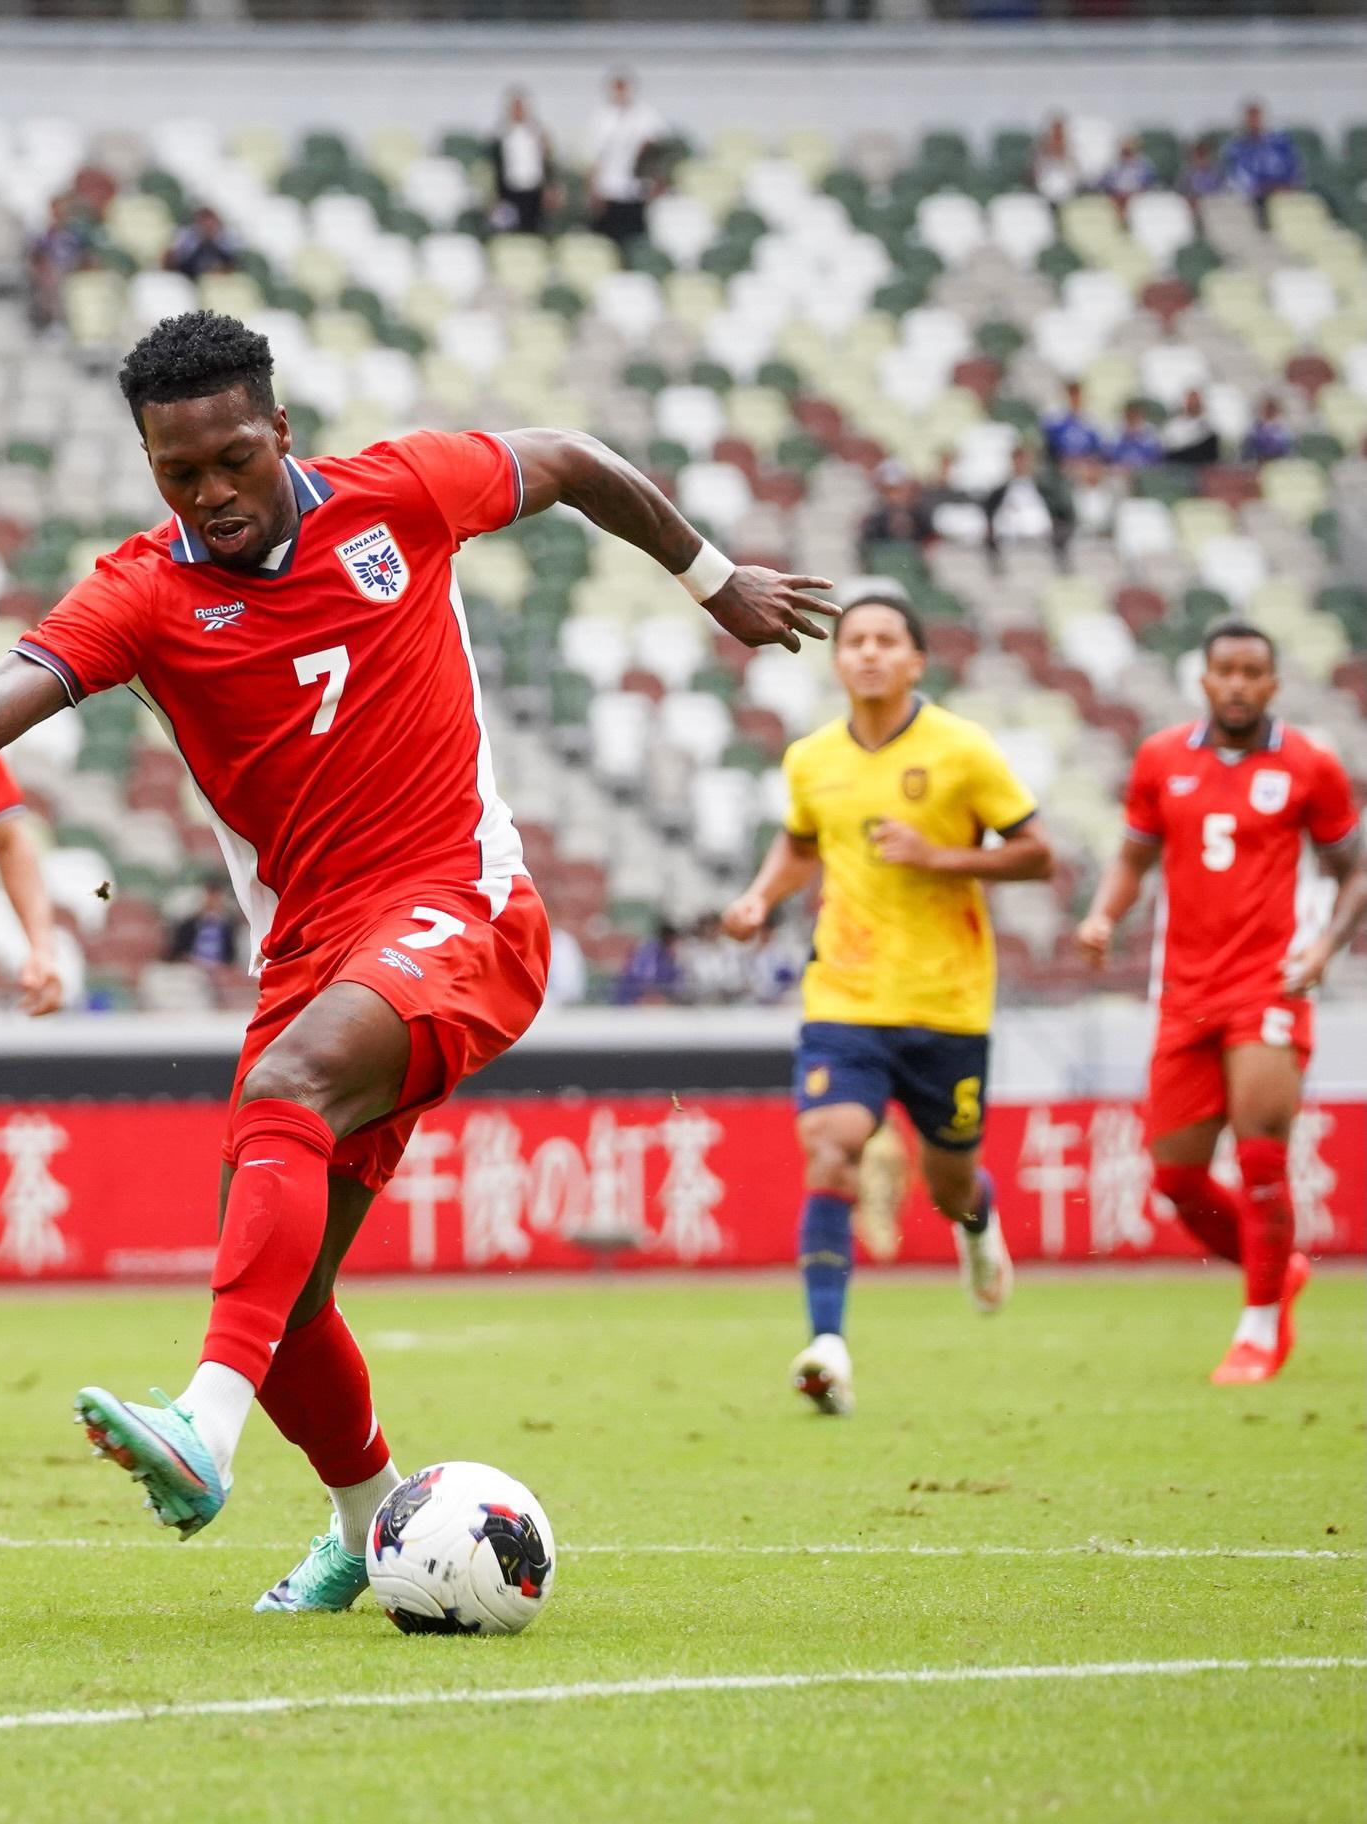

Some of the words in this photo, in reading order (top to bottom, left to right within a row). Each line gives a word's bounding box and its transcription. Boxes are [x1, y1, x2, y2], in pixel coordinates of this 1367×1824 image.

[194, 600, 246, 619] Reebok
[292, 644, 351, 736] 7
[1201, 812, 1237, 872] 5
[396, 906, 467, 950] 7
[381, 947, 424, 978] Reebok
